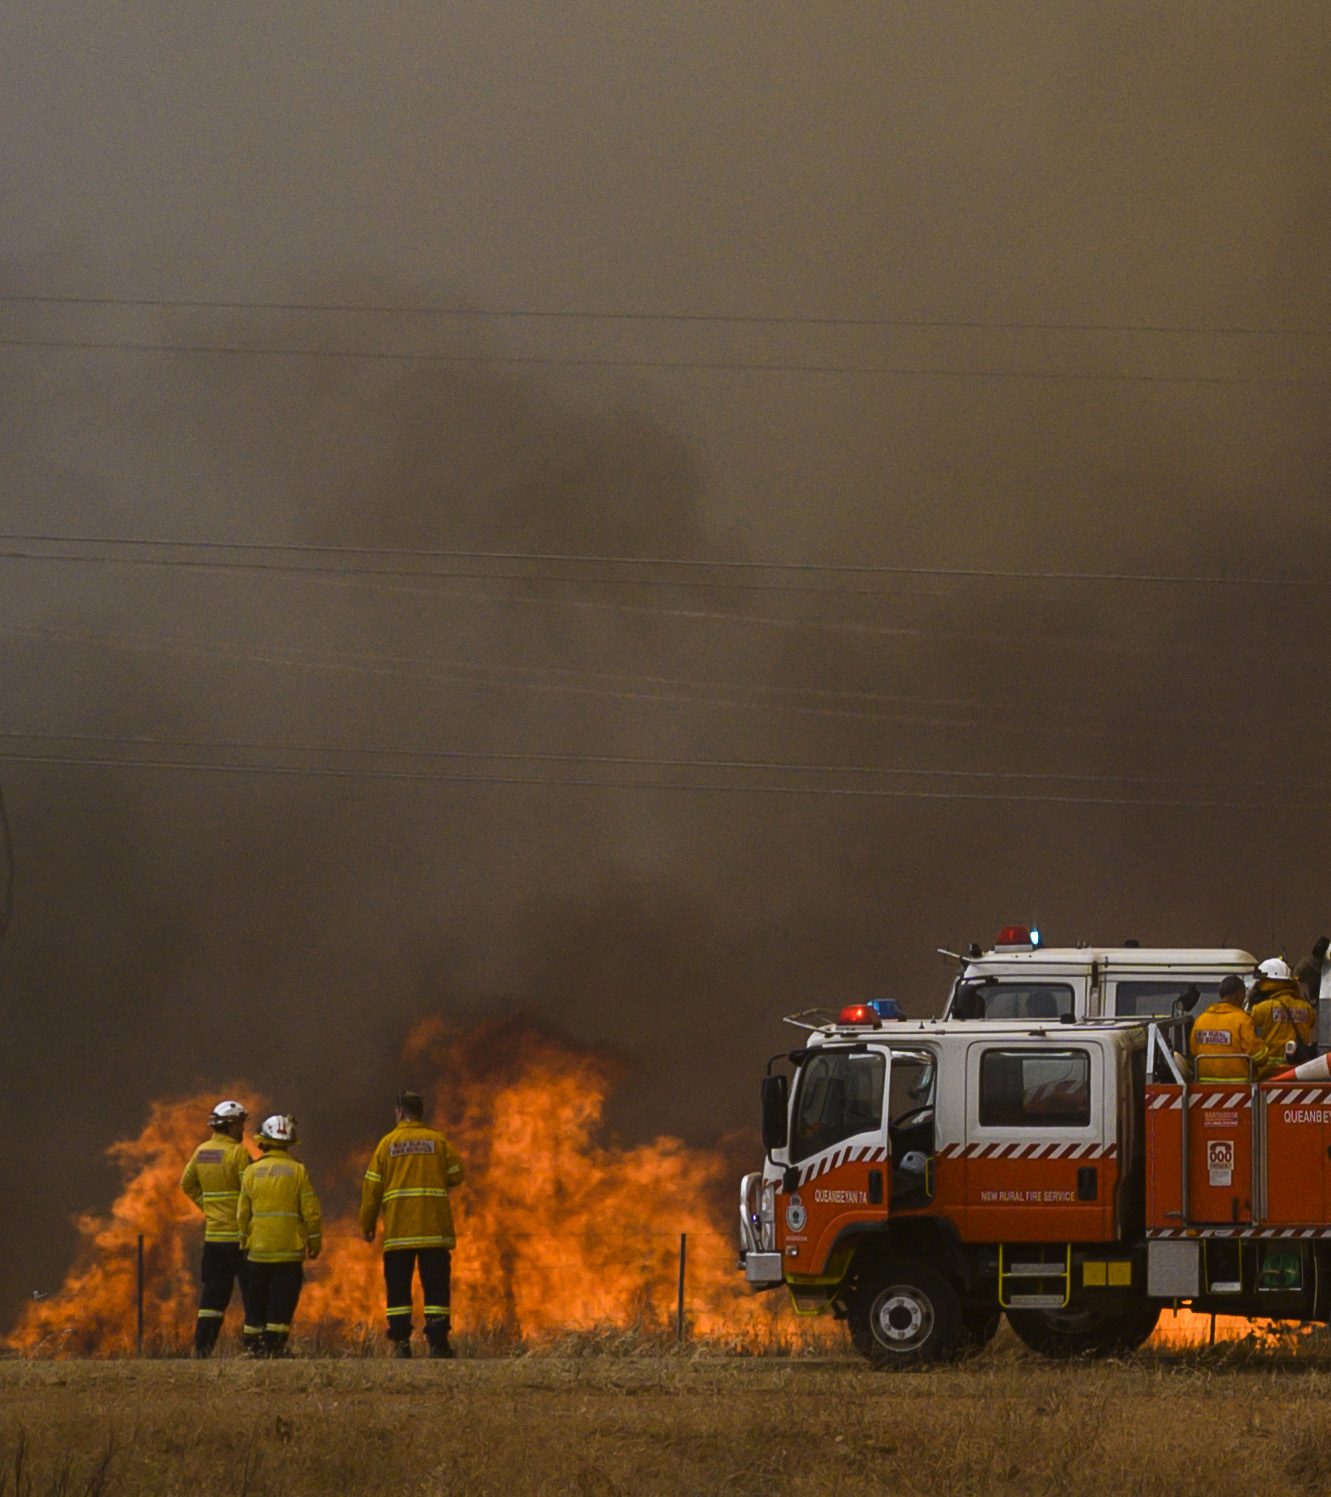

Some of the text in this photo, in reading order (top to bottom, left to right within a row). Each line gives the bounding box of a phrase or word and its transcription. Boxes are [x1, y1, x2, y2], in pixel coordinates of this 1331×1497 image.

[1210, 1150, 1232, 1162] 000
[814, 1189, 858, 1204] QUEANBEYAN
[999, 1191, 1024, 1201] RURAL
[1026, 1191, 1042, 1201] FIRE
[1043, 1191, 1075, 1201] SERVICE
